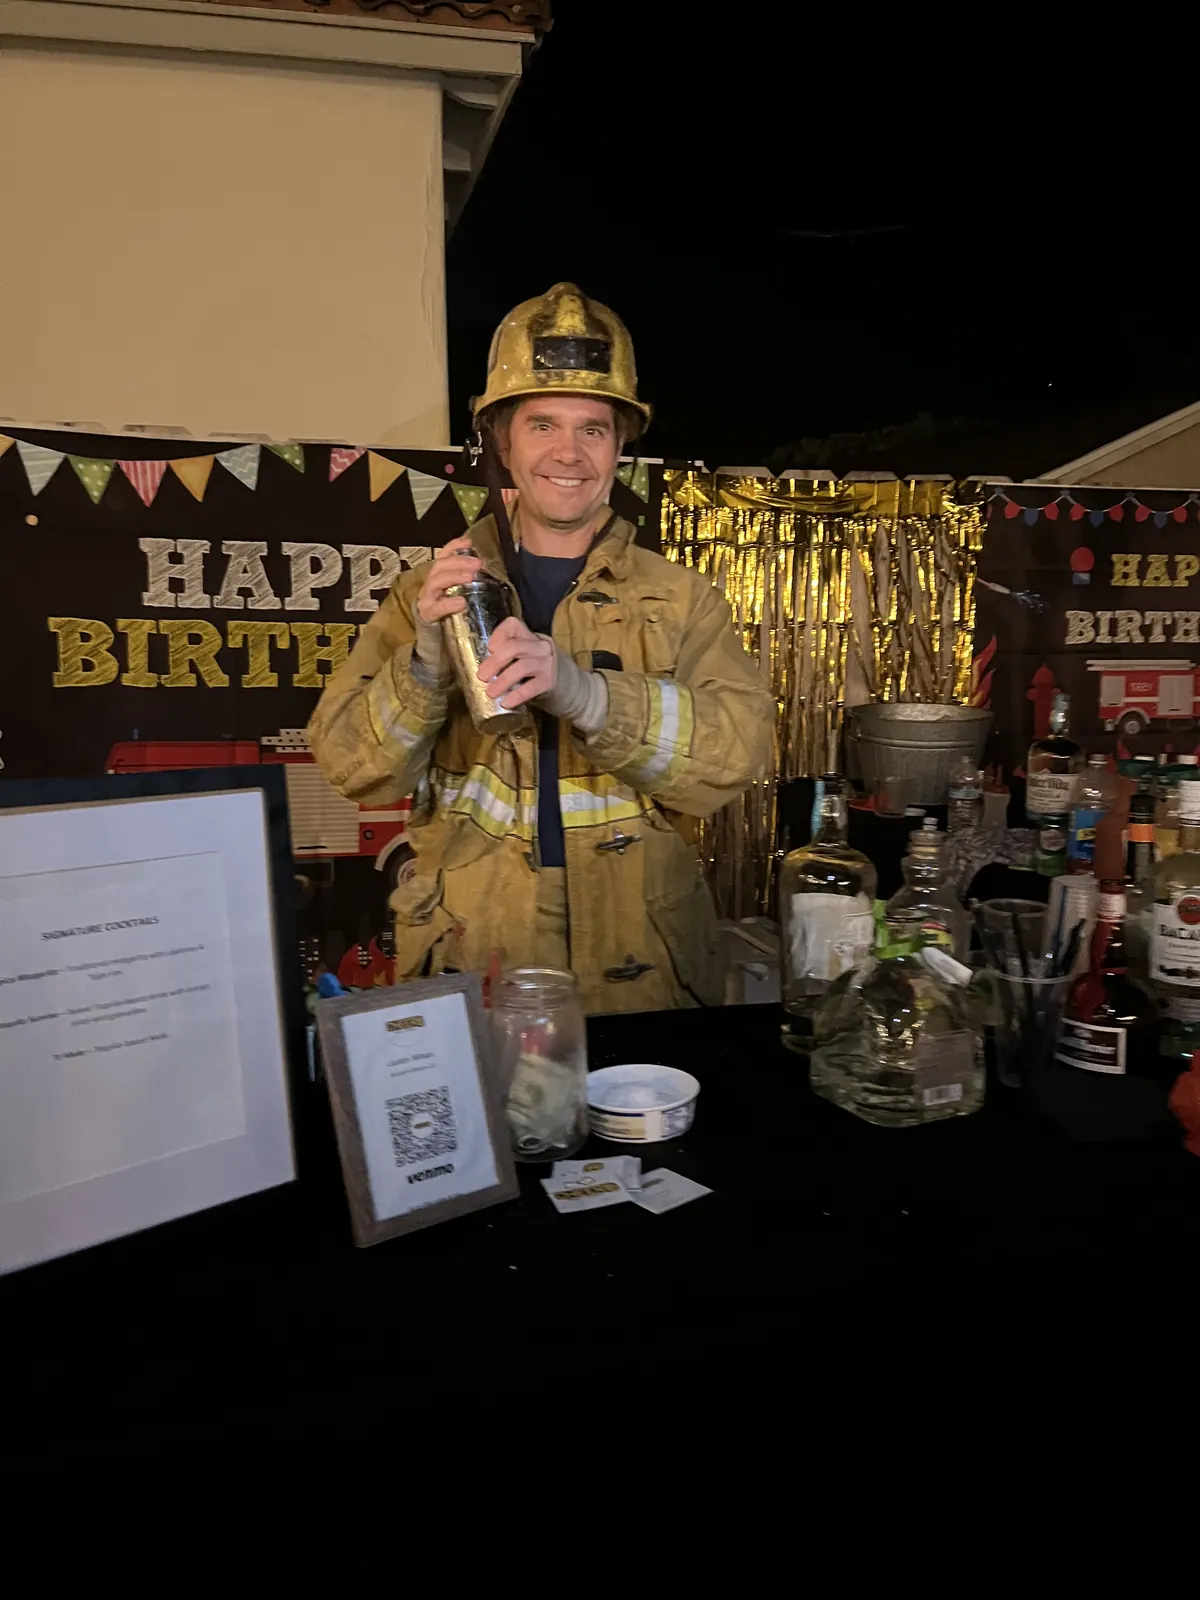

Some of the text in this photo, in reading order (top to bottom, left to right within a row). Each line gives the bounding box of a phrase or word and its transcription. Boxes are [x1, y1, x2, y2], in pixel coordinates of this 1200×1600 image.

[1111, 553, 1200, 588] HAP
[1065, 609, 1200, 645] BIRTH
[48, 616, 364, 688] BIRTH
[40, 915, 160, 941] SIGNATURE COCKTAILS
